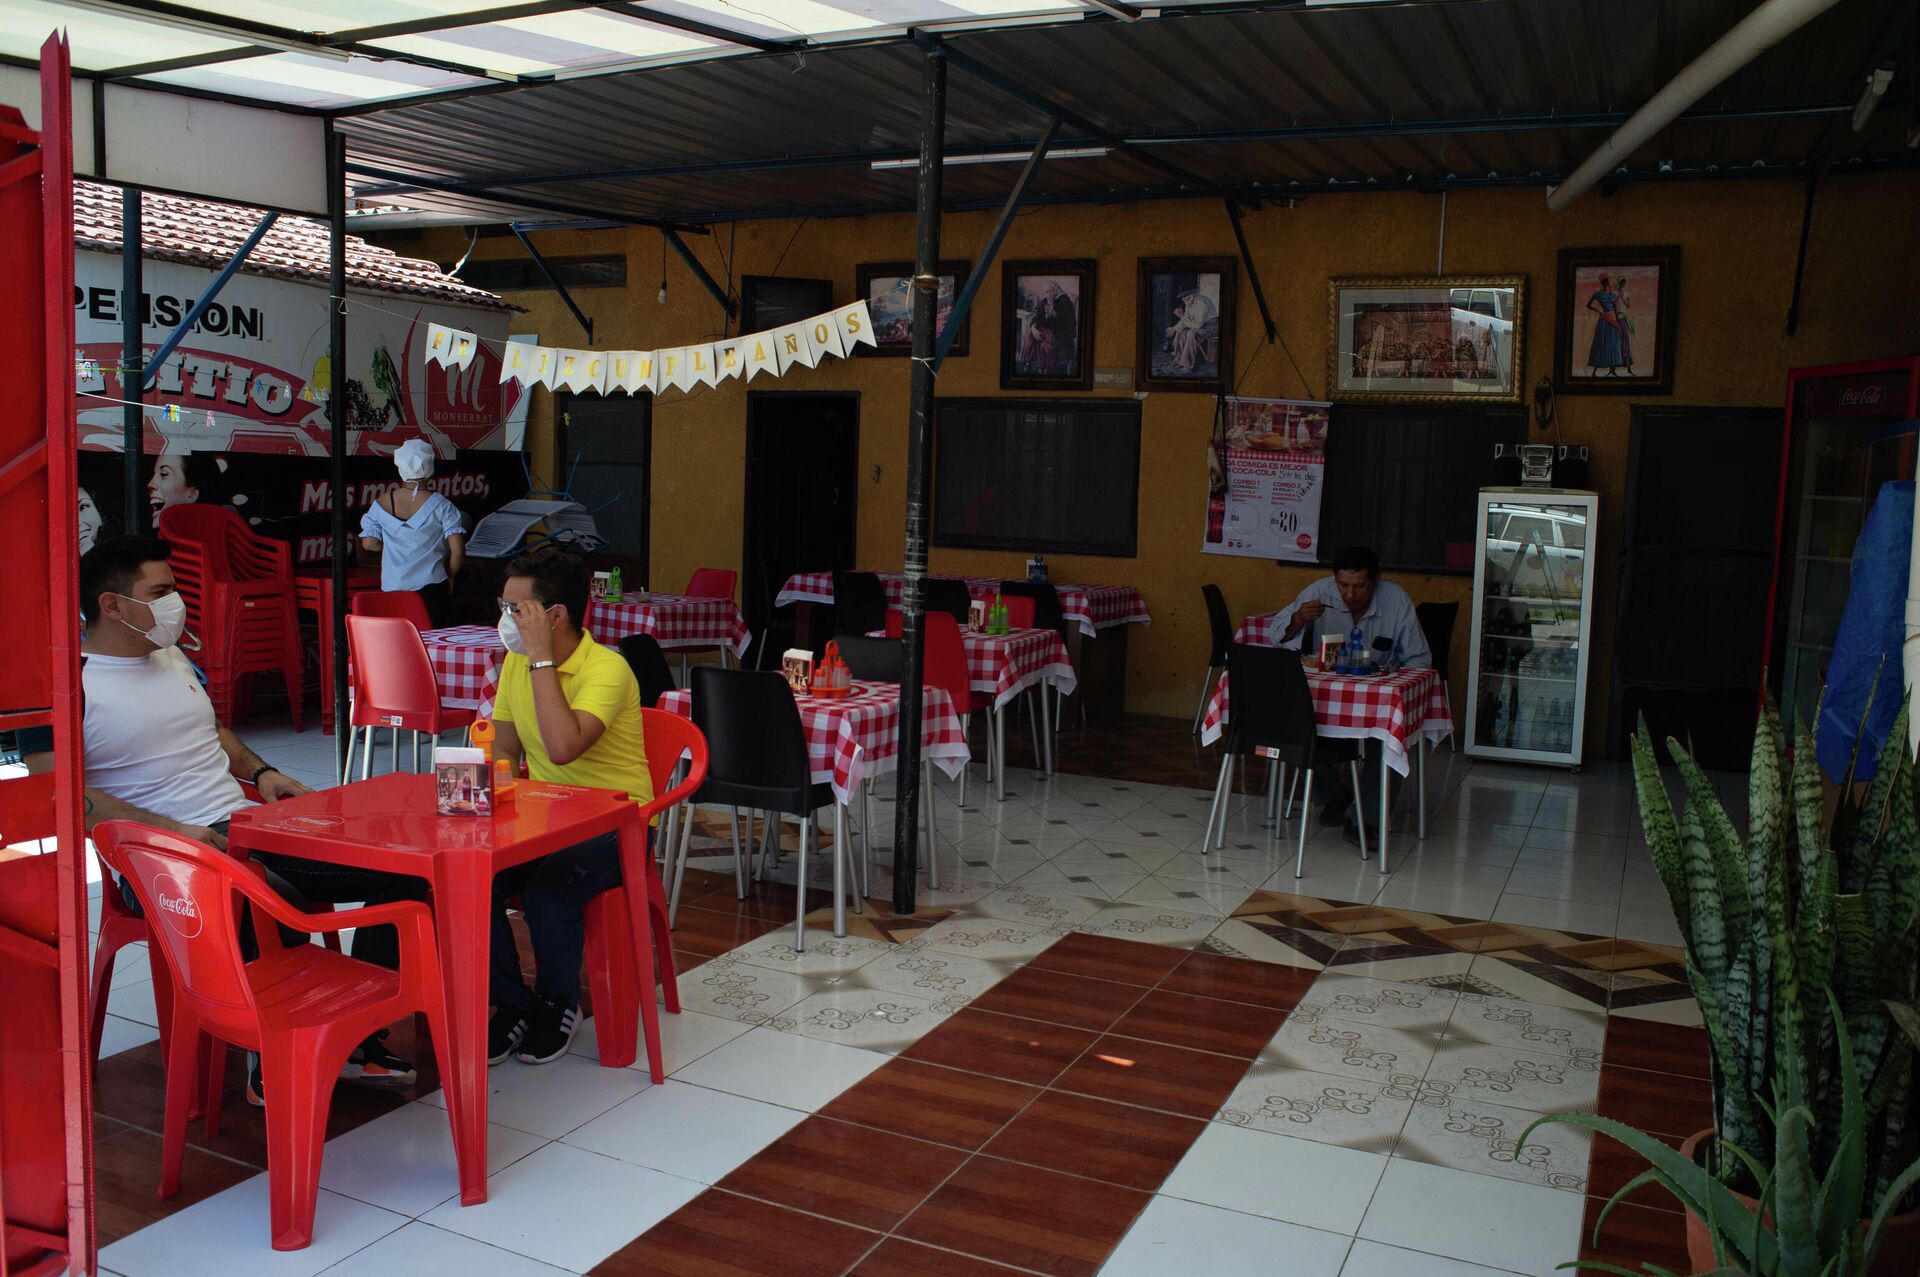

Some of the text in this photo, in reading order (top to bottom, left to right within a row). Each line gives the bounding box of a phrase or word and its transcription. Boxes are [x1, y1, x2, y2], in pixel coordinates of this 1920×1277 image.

[75, 286, 259, 338] ESION
[433, 411, 494, 423] MONSERRAT
[1232, 467, 1276, 476] COCA-COLA
[1237, 460, 1267, 469] COMIDA
[1280, 463, 1308, 472] MEJOR
[361, 474, 488, 504] moentos,
[159, 893, 196, 918] Coca-Cola
